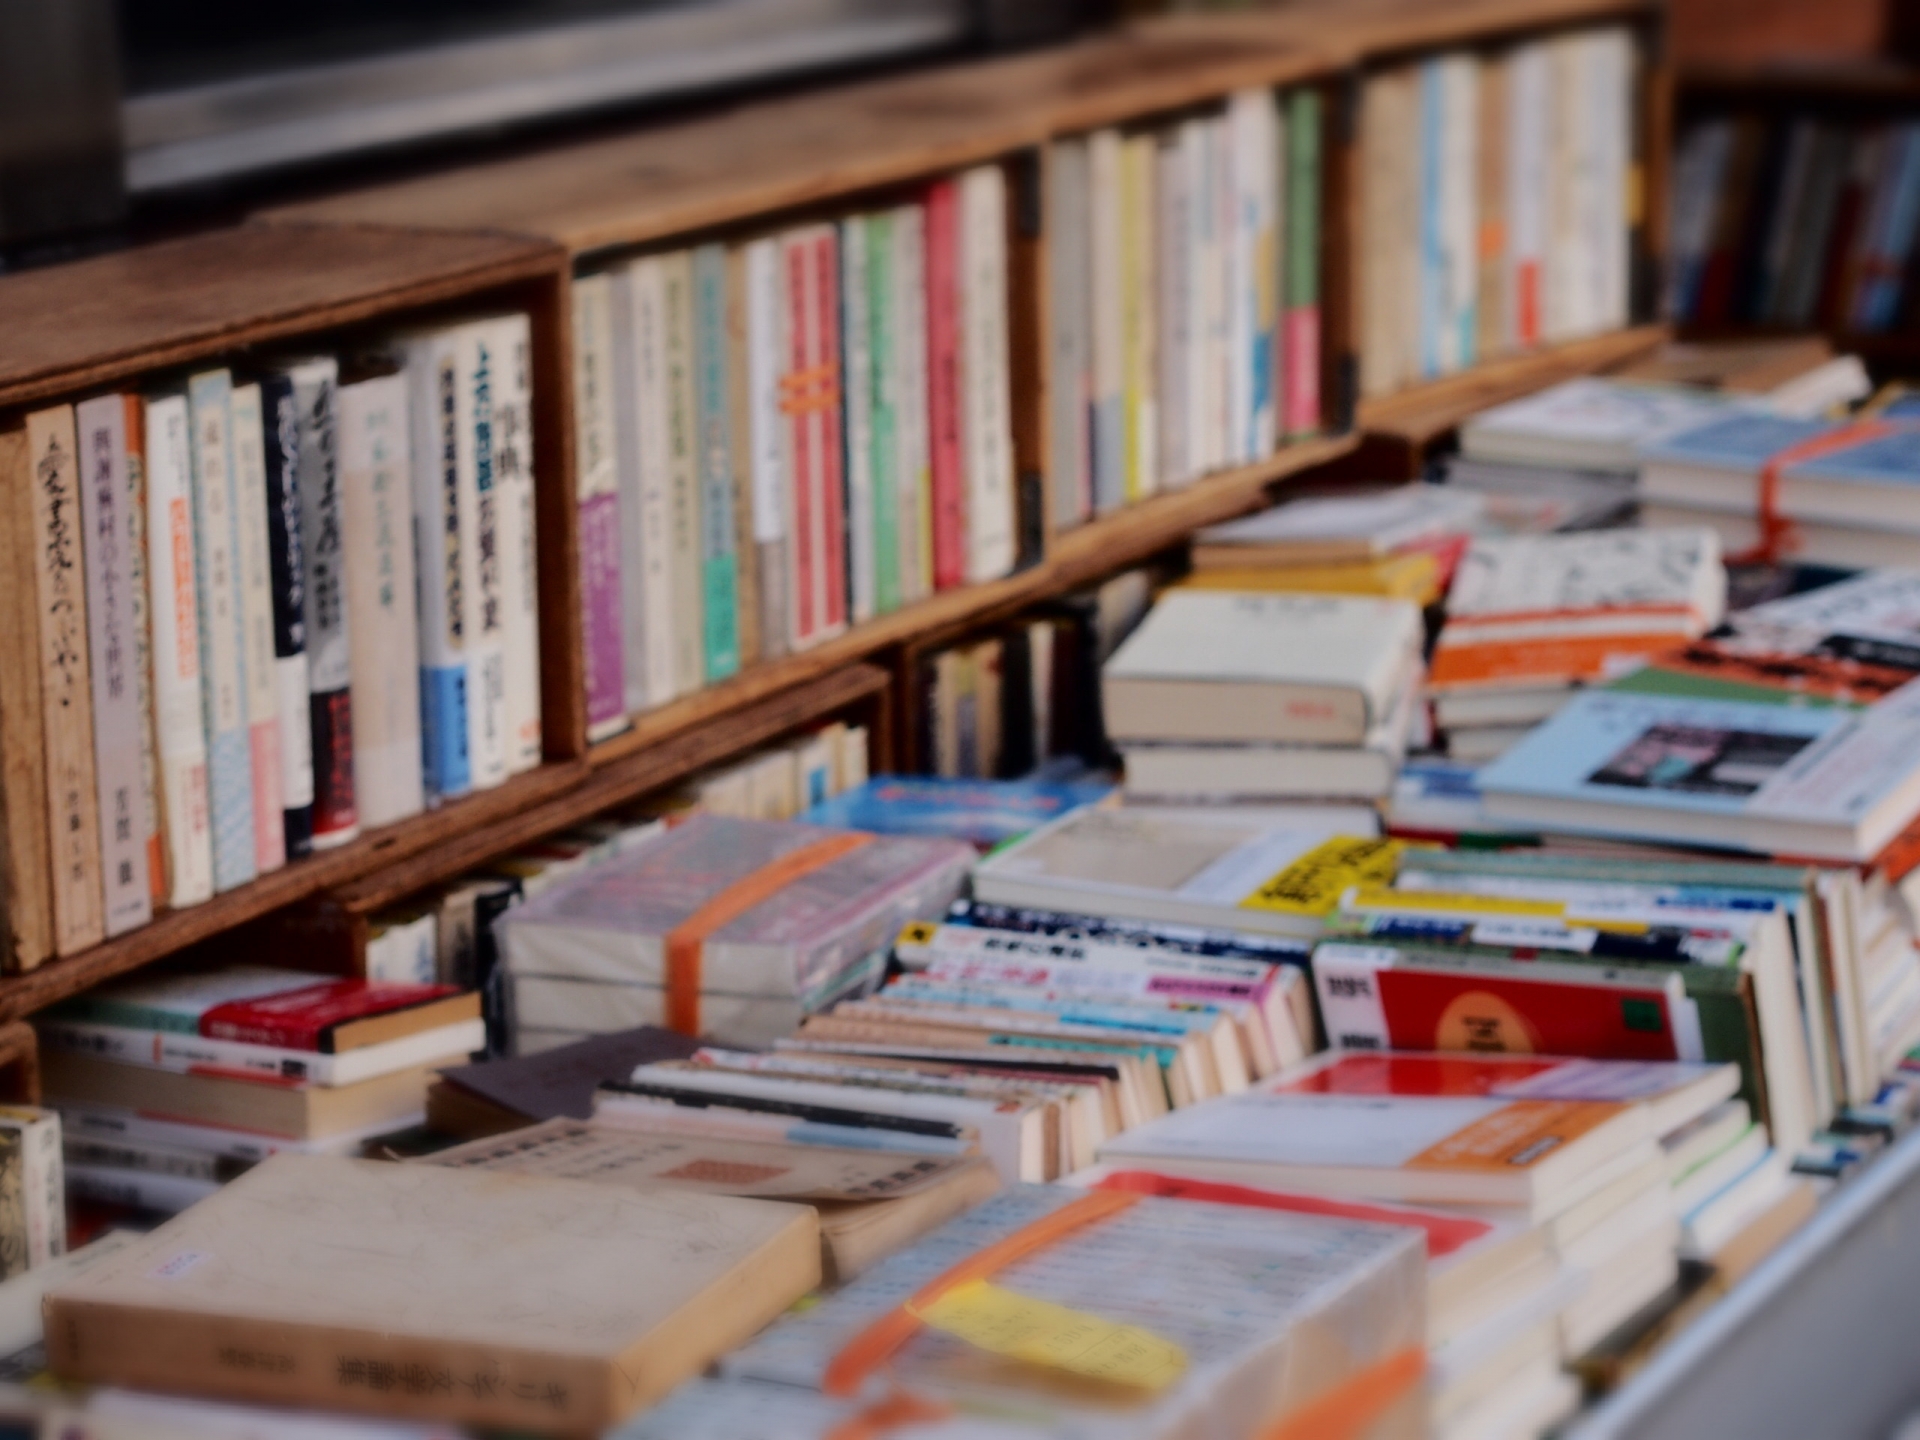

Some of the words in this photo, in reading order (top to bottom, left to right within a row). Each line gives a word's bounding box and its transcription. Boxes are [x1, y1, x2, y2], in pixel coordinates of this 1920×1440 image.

[337, 1354, 568, 1410] ギリシア文学論集
